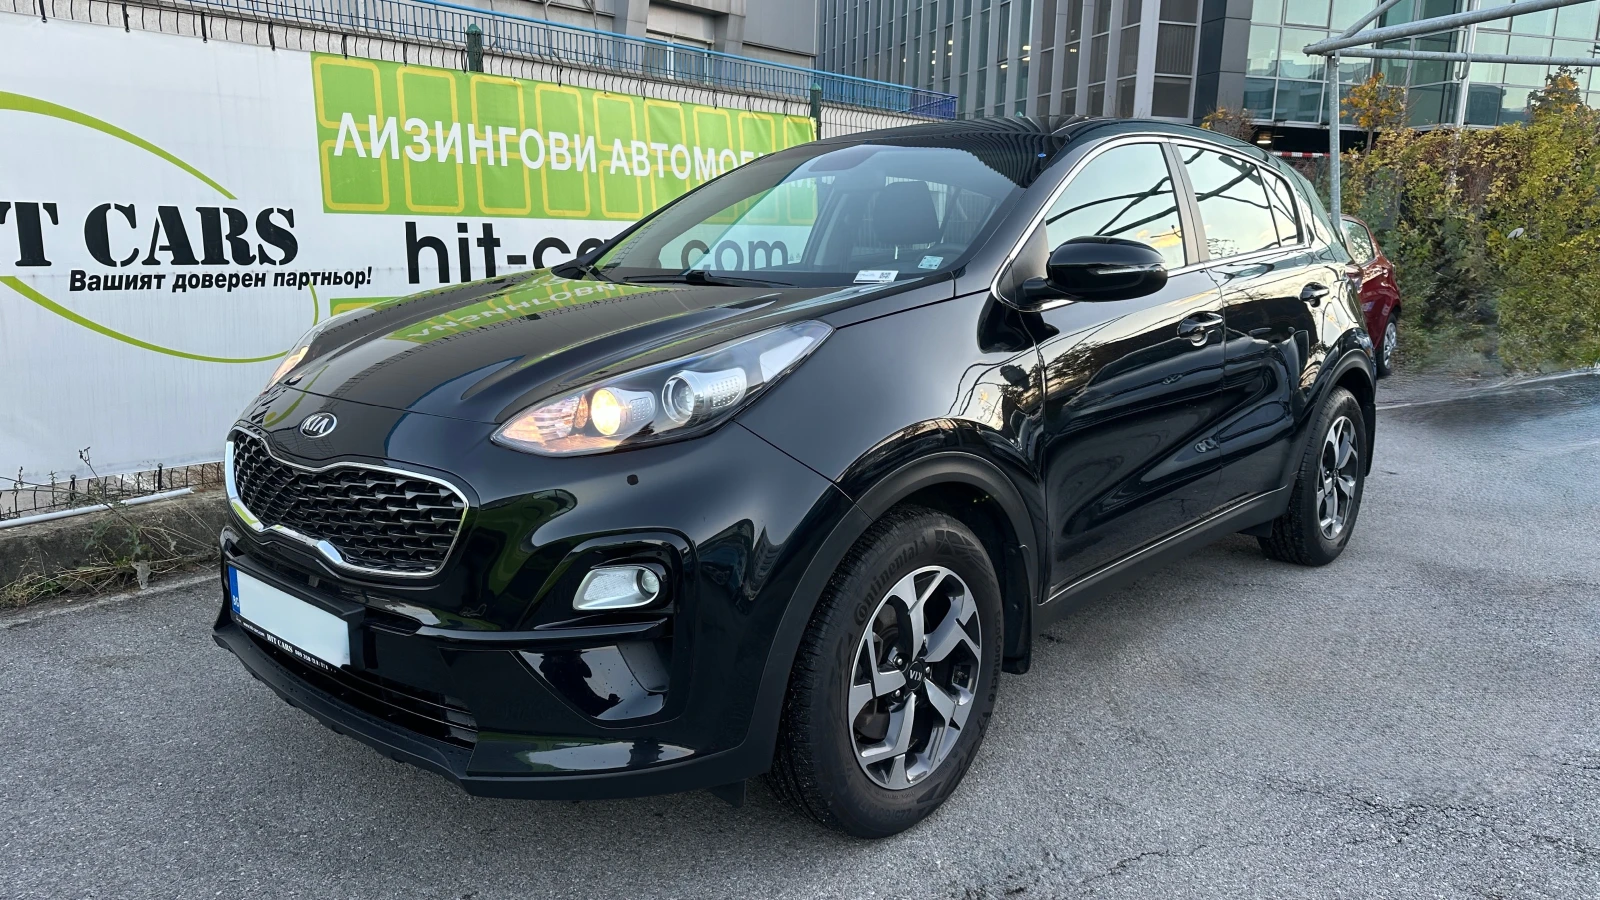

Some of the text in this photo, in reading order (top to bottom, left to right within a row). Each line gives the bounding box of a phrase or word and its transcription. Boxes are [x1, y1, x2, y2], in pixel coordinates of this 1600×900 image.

[334, 112, 775, 181] ЛИЗИНГОВИ АВТОМО
[84, 203, 299, 268] CARS
[69, 266, 373, 293] Вашият доверен партньор!
[302, 415, 330, 434] KIA
[854, 540, 919, 626] Continental
